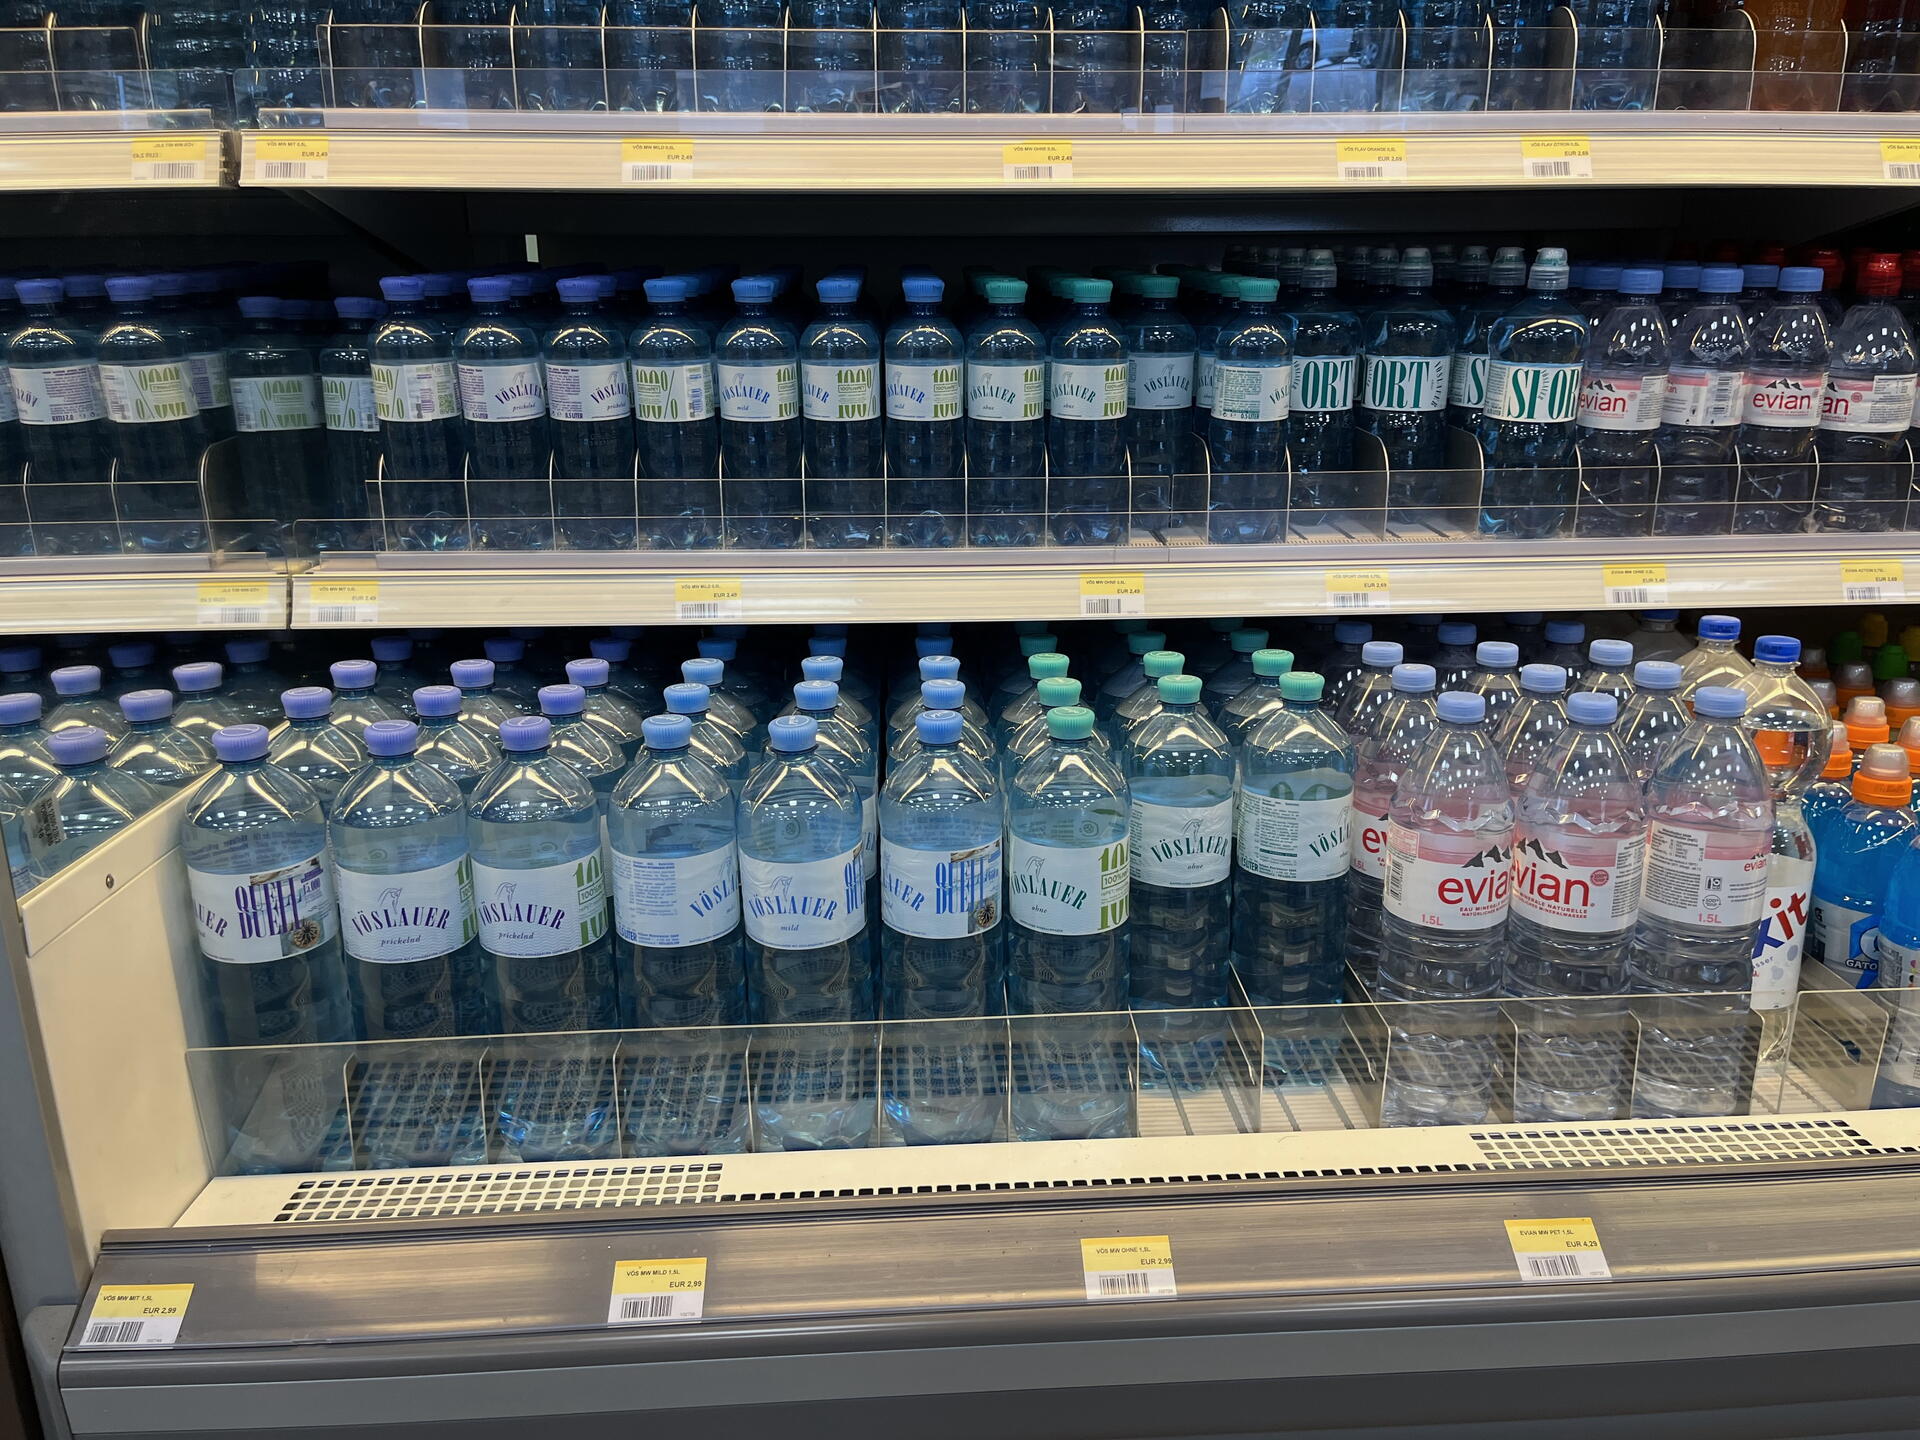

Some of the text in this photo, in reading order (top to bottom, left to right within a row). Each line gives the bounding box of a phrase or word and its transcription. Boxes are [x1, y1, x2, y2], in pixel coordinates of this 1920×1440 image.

[1752, 391, 1811, 411] evian
[1151, 836, 1228, 862] VÖSLAUER
[1011, 871, 1087, 911] VÖSLAUER
[748, 894, 837, 921] VÖSLAUER
[1031, 904, 1048, 914] ohne
[352, 906, 450, 936] VÖSLAUER
[479, 901, 565, 930] VÖSLAUER
[1421, 914, 1443, 926] 1.5L
[1698, 912, 1722, 923] 1.5L
[781, 924, 800, 932] mild
[381, 935, 421, 947] prickelnd
[1846, 959, 1878, 971] GATO
[1567, 1240, 1598, 1248] EUR 4,29
[1158, 1257, 1172, 1265] 2,99
[687, 1279, 702, 1288] 2,99
[161, 1307, 177, 1315] 2,99
